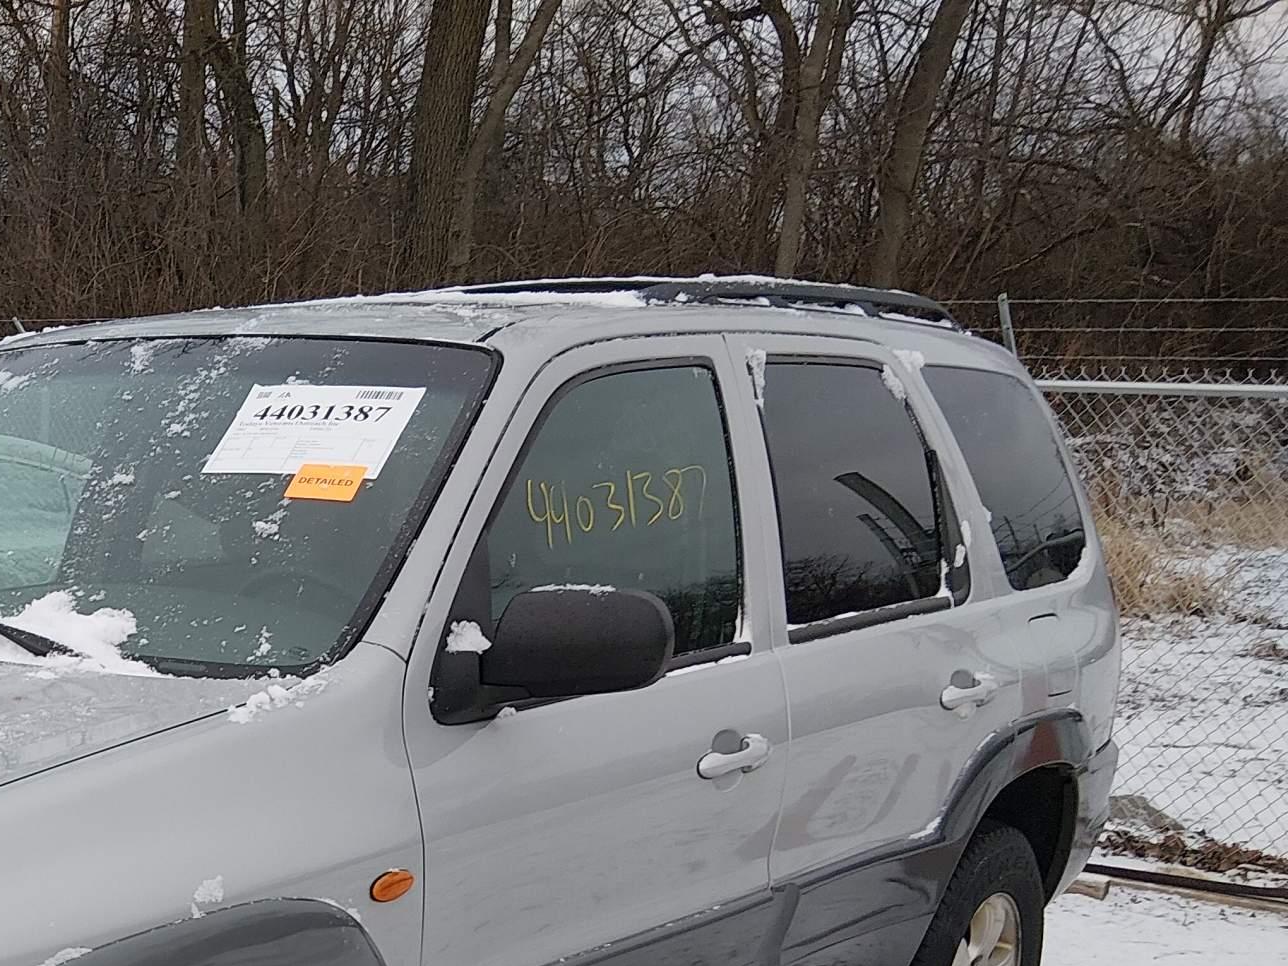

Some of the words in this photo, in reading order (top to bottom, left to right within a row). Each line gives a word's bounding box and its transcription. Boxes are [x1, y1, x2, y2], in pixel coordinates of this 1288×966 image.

[253, 404, 392, 422] 44031387
[298, 476, 354, 487] DETAILED
[526, 465, 707, 549] 44031387
